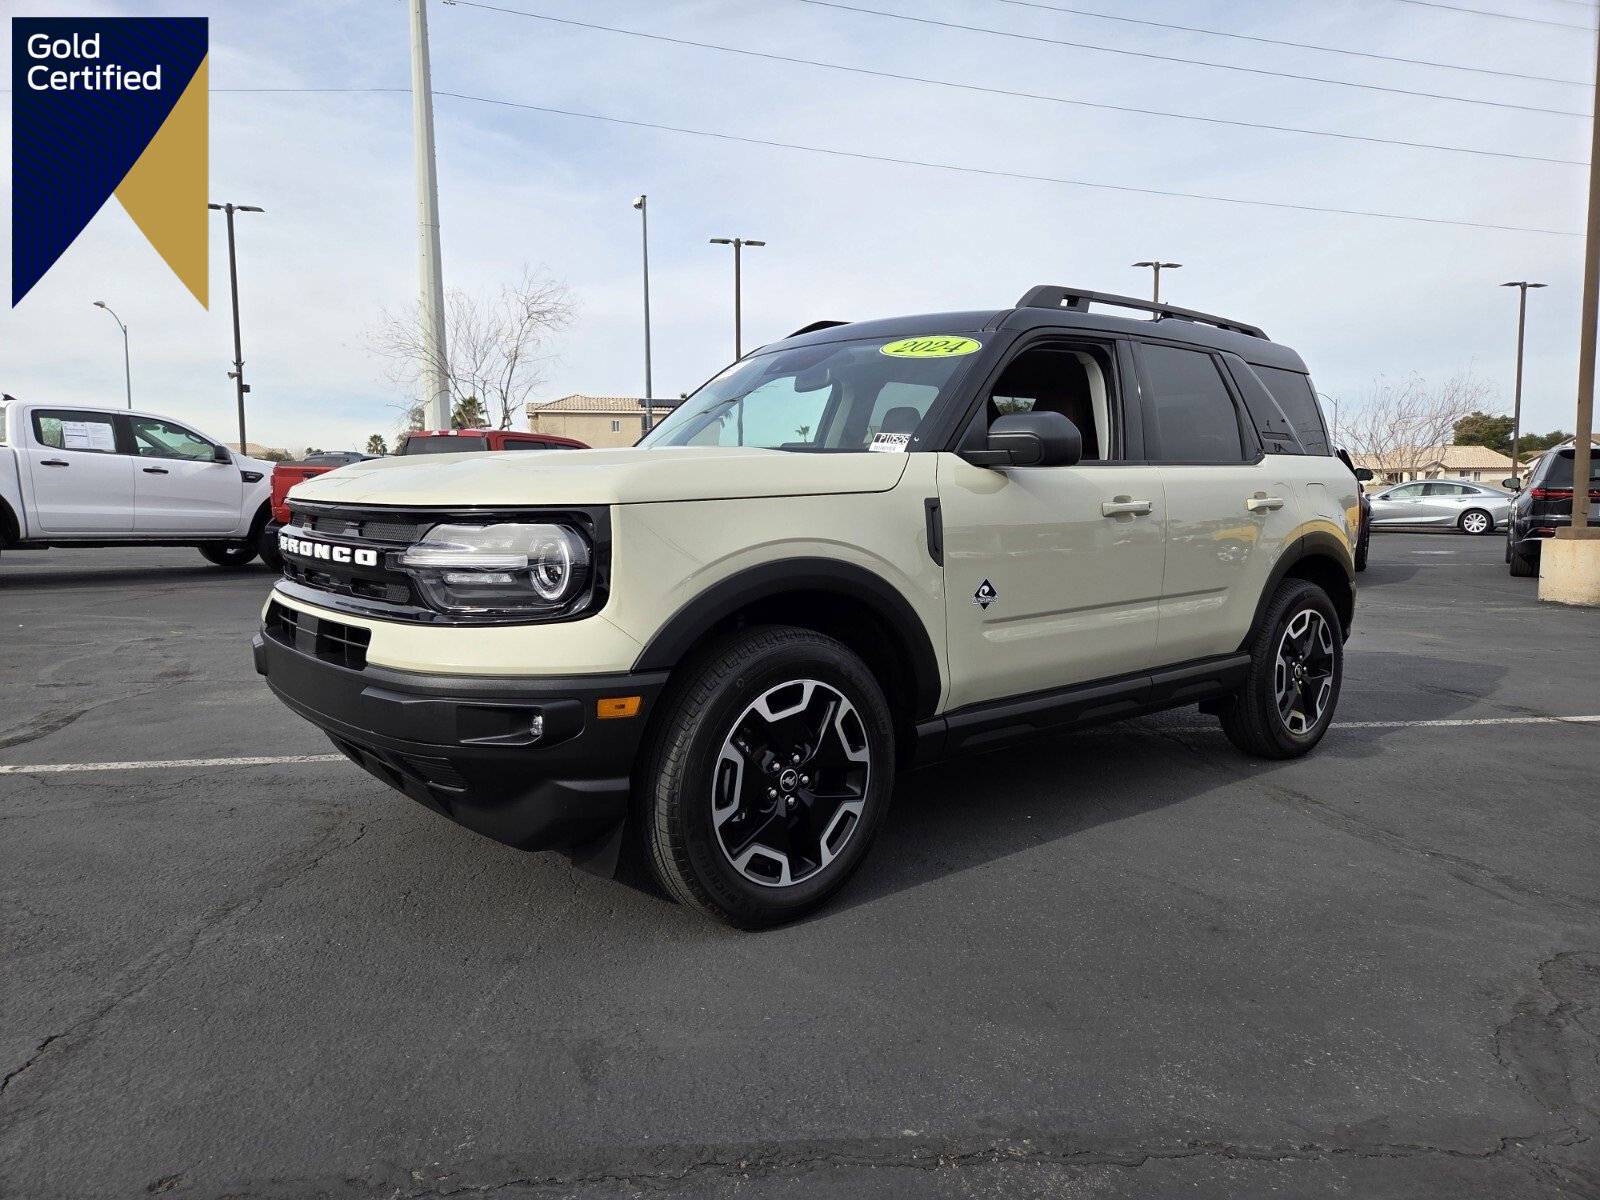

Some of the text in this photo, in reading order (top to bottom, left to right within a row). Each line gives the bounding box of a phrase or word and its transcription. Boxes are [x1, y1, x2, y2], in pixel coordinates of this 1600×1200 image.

[892, 340, 968, 353] 2024
[280, 535, 377, 566] BRONCO
[694, 844, 738, 903] MICHELIN
